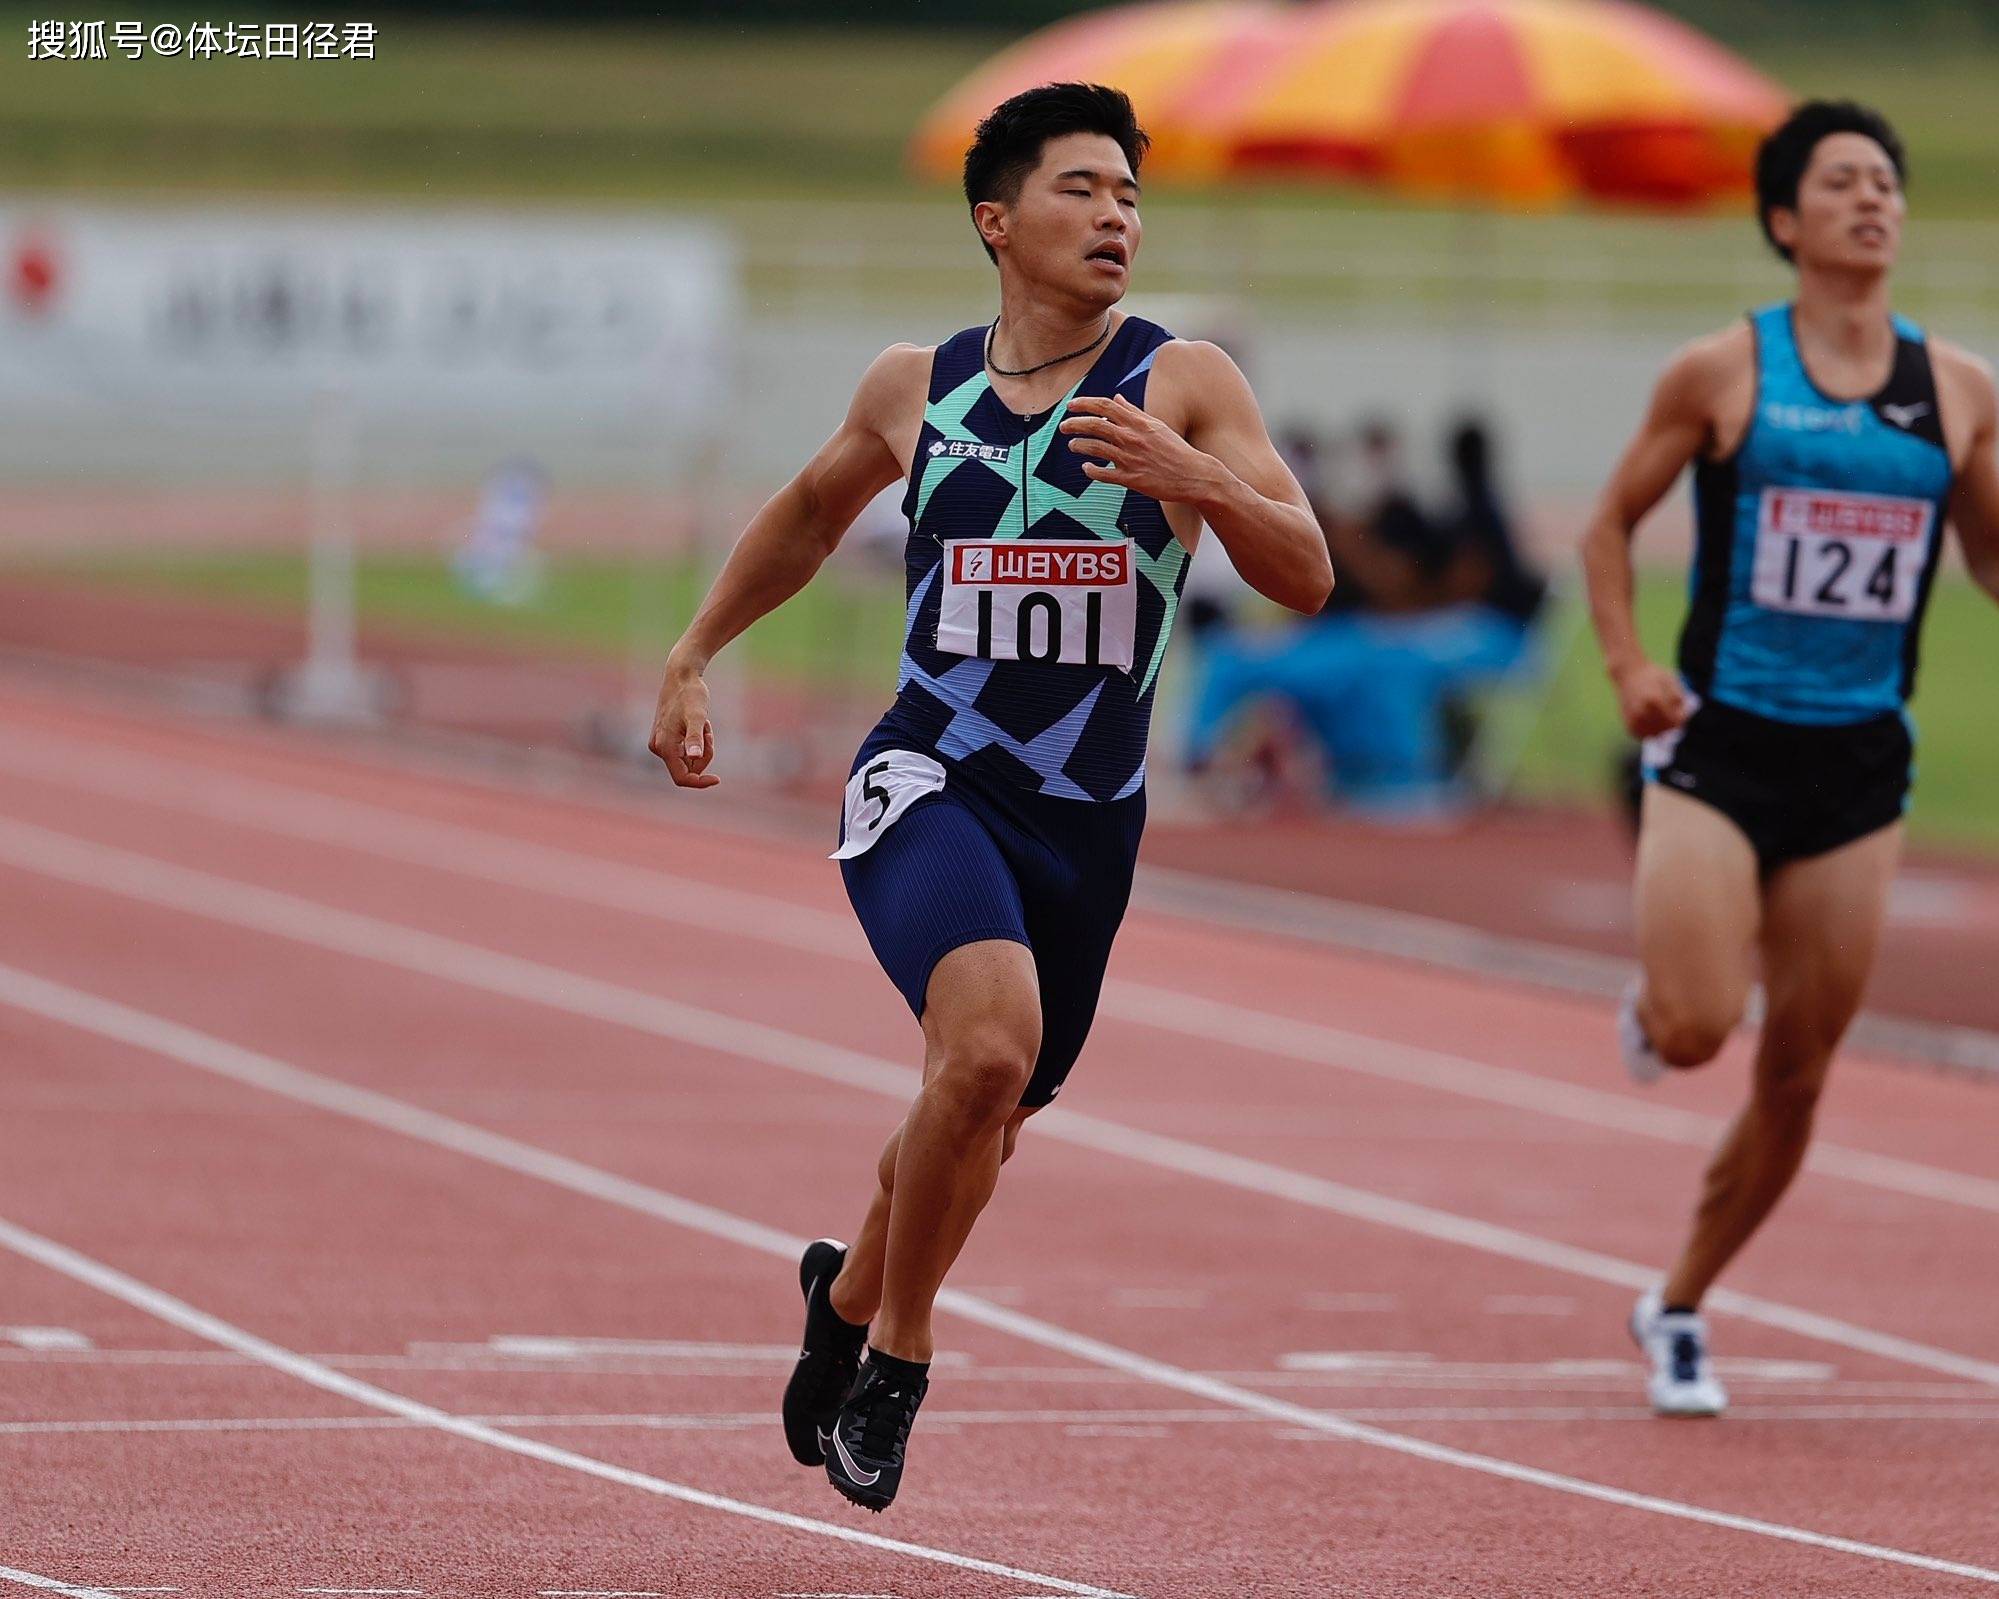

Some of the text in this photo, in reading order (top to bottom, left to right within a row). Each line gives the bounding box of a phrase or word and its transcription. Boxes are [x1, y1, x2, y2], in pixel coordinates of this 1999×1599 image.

[948, 441, 1009, 461] 住友電工
[998, 551, 1121, 580] 山日YBS
[1784, 536, 1897, 606] 124
[977, 590, 1102, 665] 101
[863, 760, 891, 831] 5
